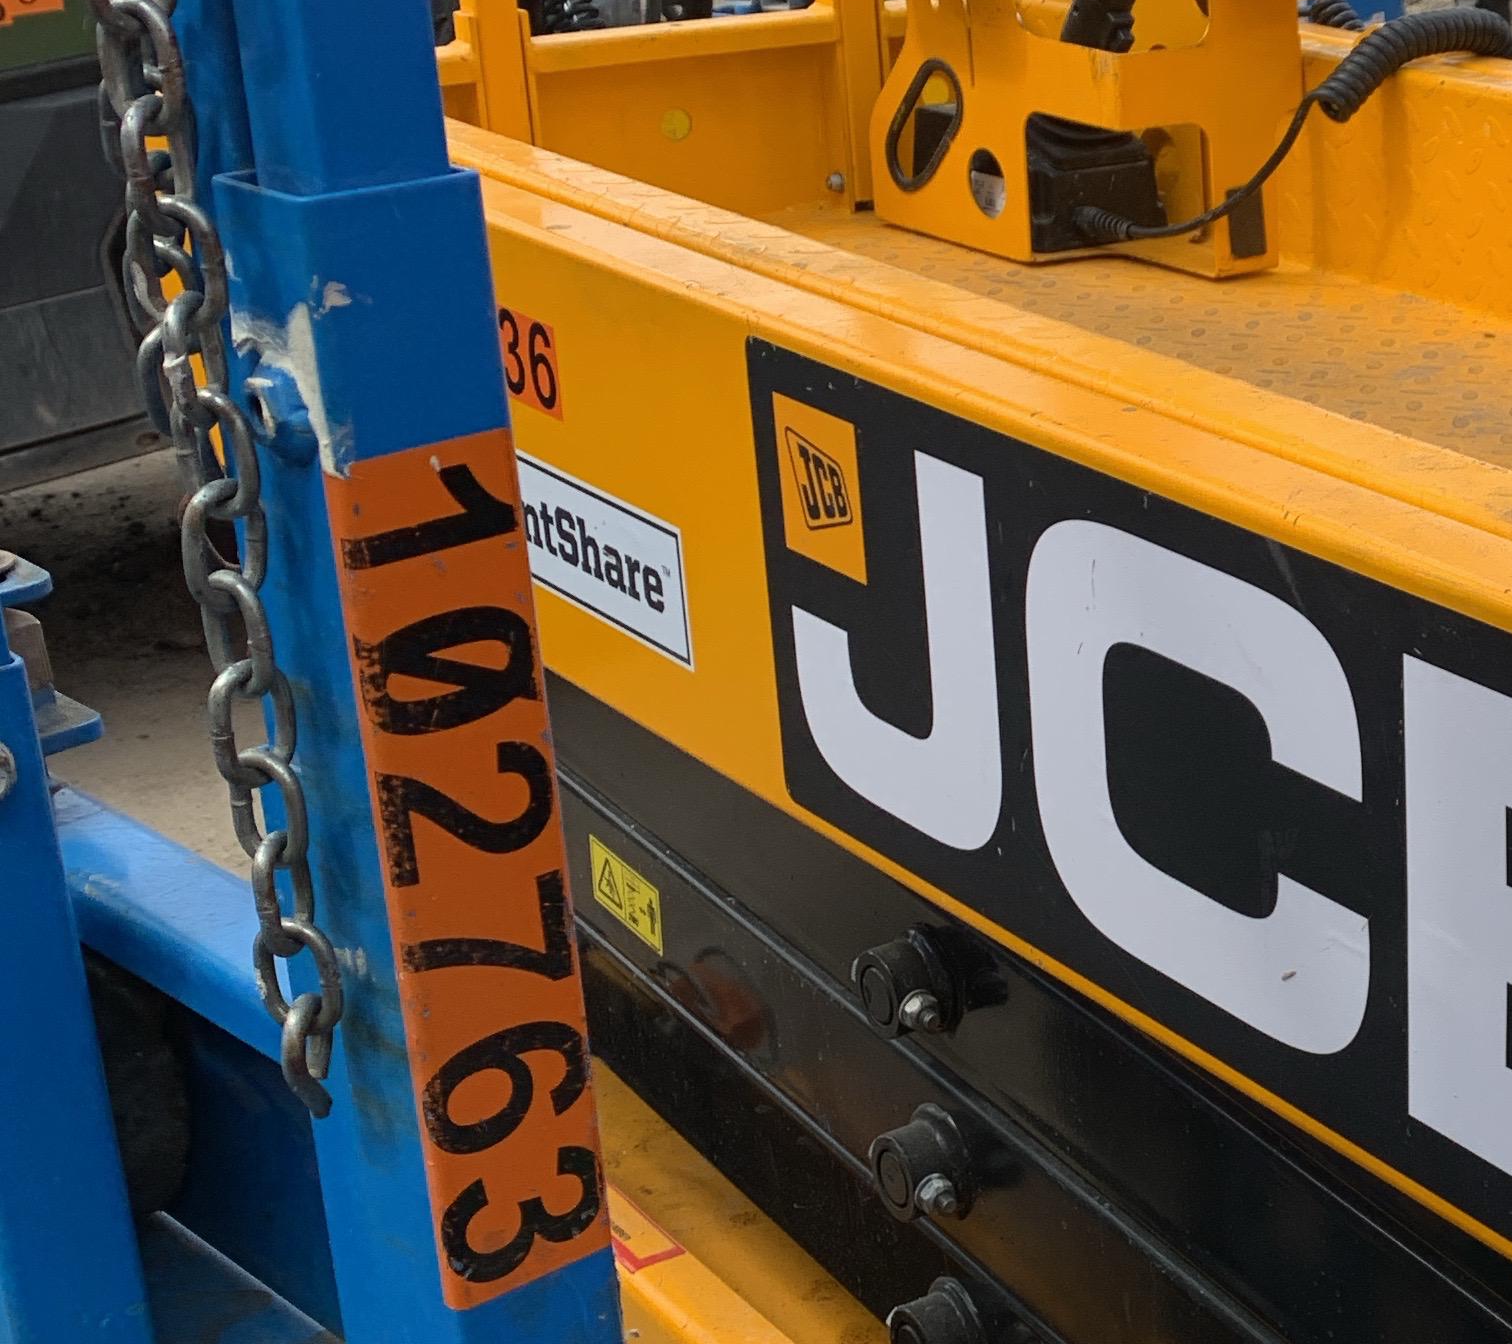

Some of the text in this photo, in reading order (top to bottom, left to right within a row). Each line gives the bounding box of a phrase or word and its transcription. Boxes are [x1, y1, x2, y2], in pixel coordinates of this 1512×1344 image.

[499, 307, 558, 411] 36
[798, 441, 849, 521] JCB
[341, 463, 602, 1285] 102763
